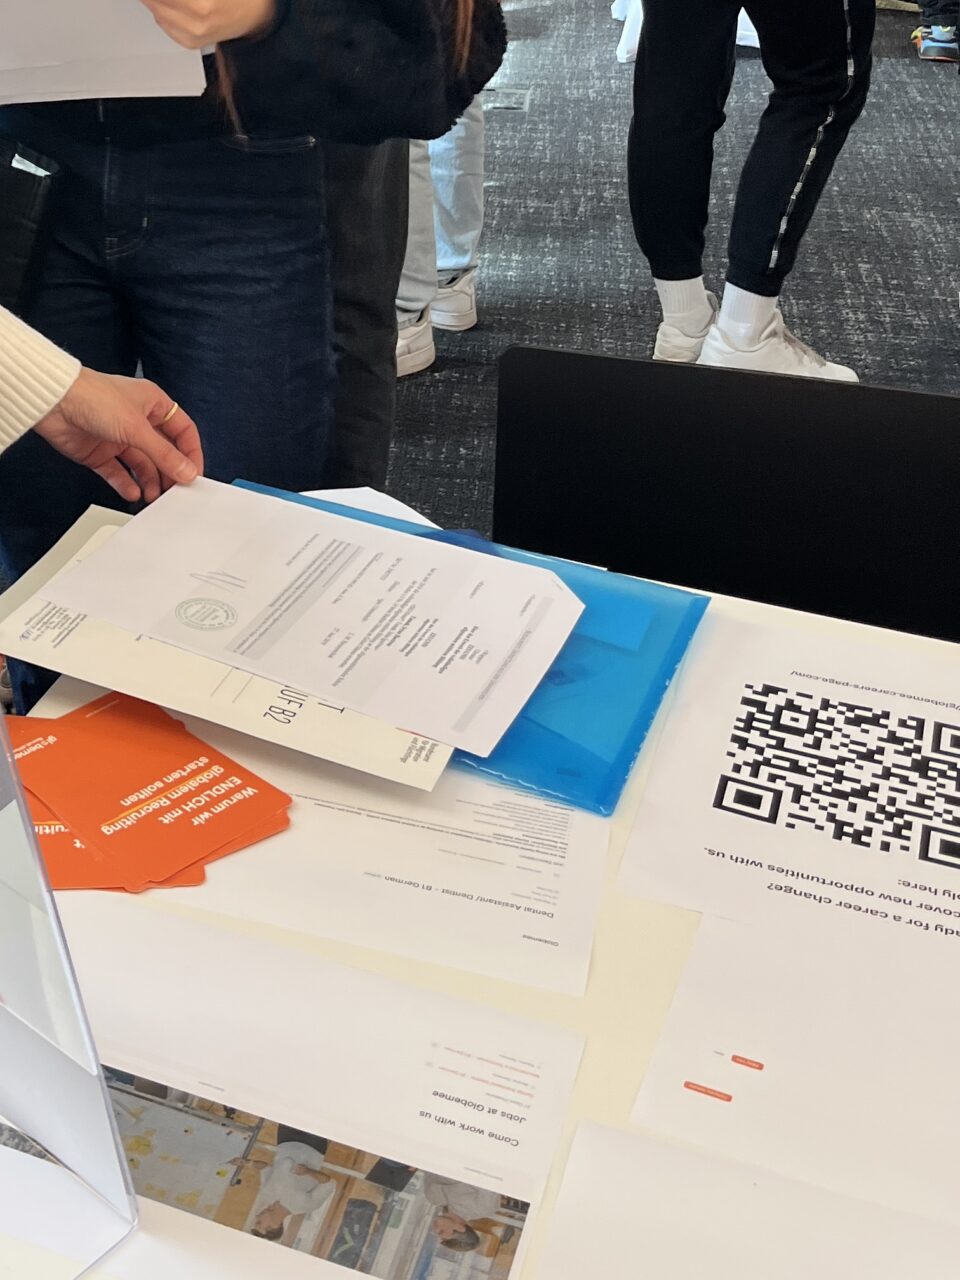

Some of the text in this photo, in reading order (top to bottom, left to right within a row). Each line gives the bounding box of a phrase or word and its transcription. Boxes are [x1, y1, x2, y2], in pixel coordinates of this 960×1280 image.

[263, 687, 309, 725] UF B2
[120, 756, 210, 807] starten sollten
[100, 764, 225, 835] globalem Recruiting
[158, 776, 243, 825] ENDLICH mit
[191, 786, 259, 826] Warum wir
[703, 847, 726, 859] us.
[729, 853, 764, 869] with
[384, 875, 420, 888] German
[767, 862, 875, 898] opportunities
[897, 878, 938, 896] here:
[441, 887, 474, 901] Dentist
[766, 881, 832, 905] change?
[878, 891, 913, 907] new
[475, 895, 522, 911] Assistant/
[836, 900, 889, 919] career
[523, 906, 555, 919] Dental
[892, 914, 902, 923] a
[905, 918, 930, 931] for
[432, 1090, 485, 1112] Globemee
[487, 1106, 498, 1115] at
[500, 1111, 527, 1124] Jobs
[419, 1110, 520, 1147] Come work with us
